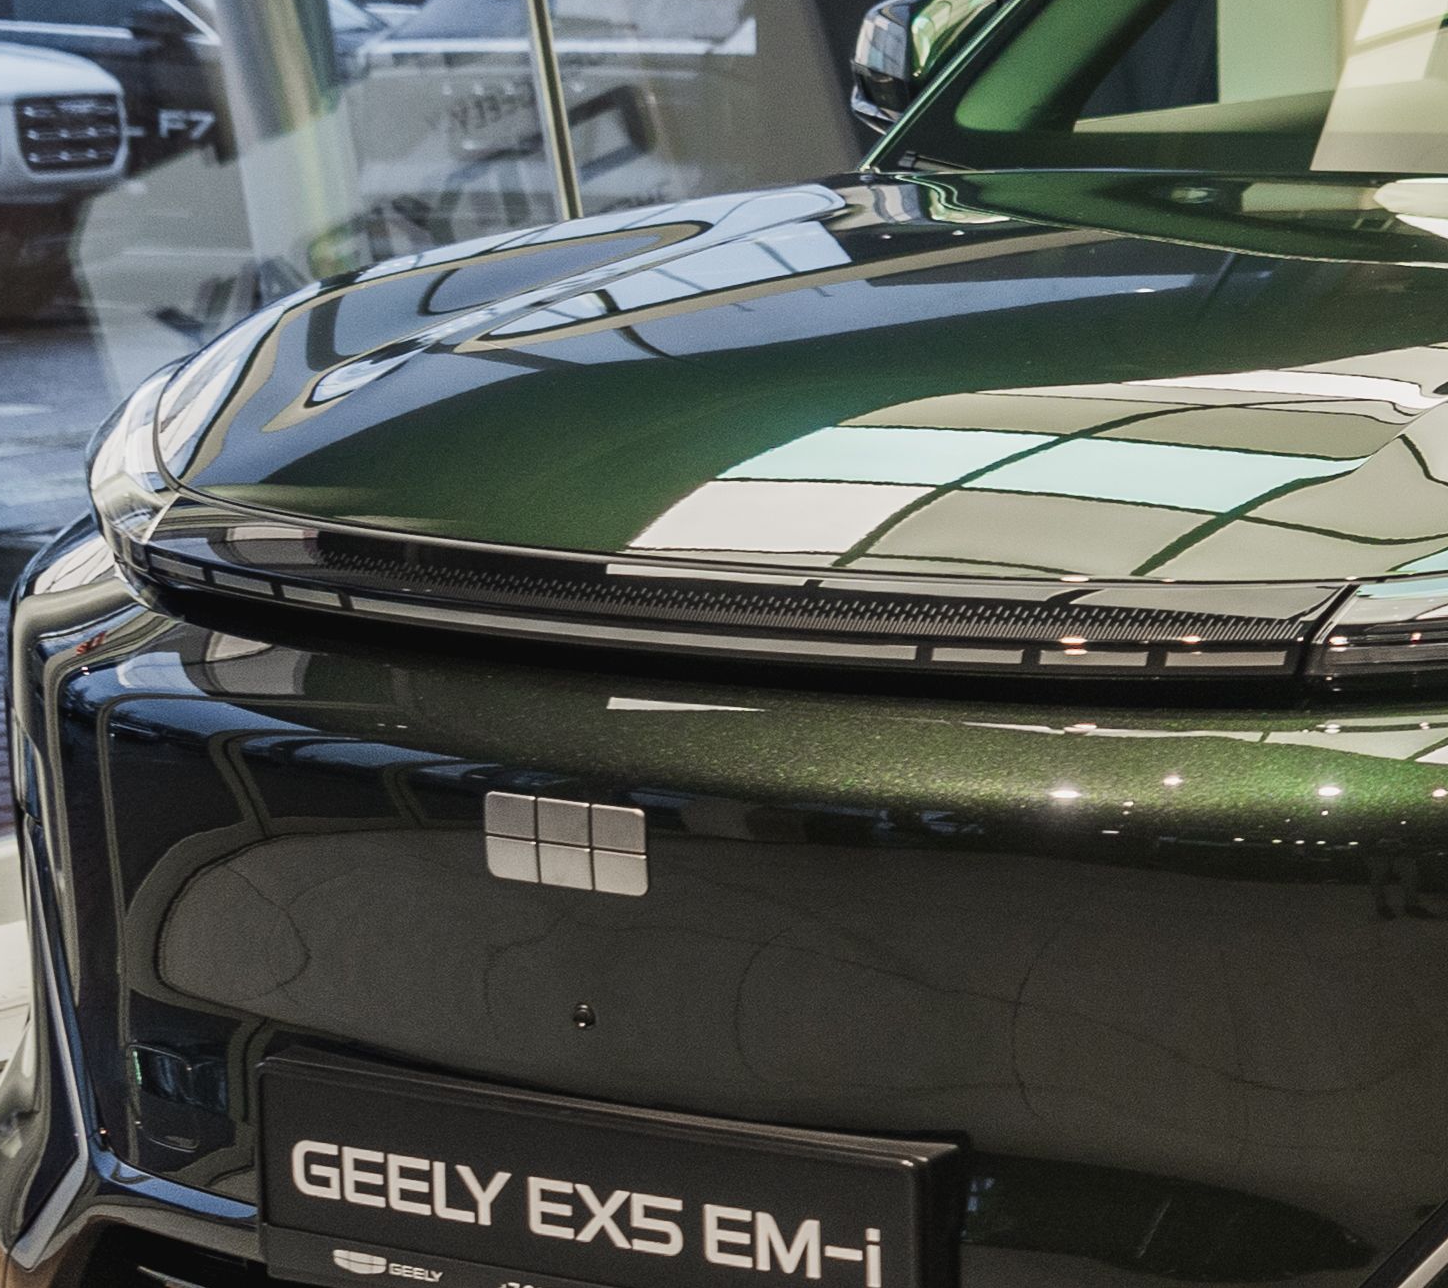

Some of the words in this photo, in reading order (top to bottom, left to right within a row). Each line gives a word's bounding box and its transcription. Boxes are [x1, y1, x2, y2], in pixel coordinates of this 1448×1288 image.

[291, 1139, 512, 1226] GEELY
[527, 1175, 684, 1257] EX5
[702, 1203, 882, 1288] EM-i
[388, 1262, 444, 1283] GEELY
